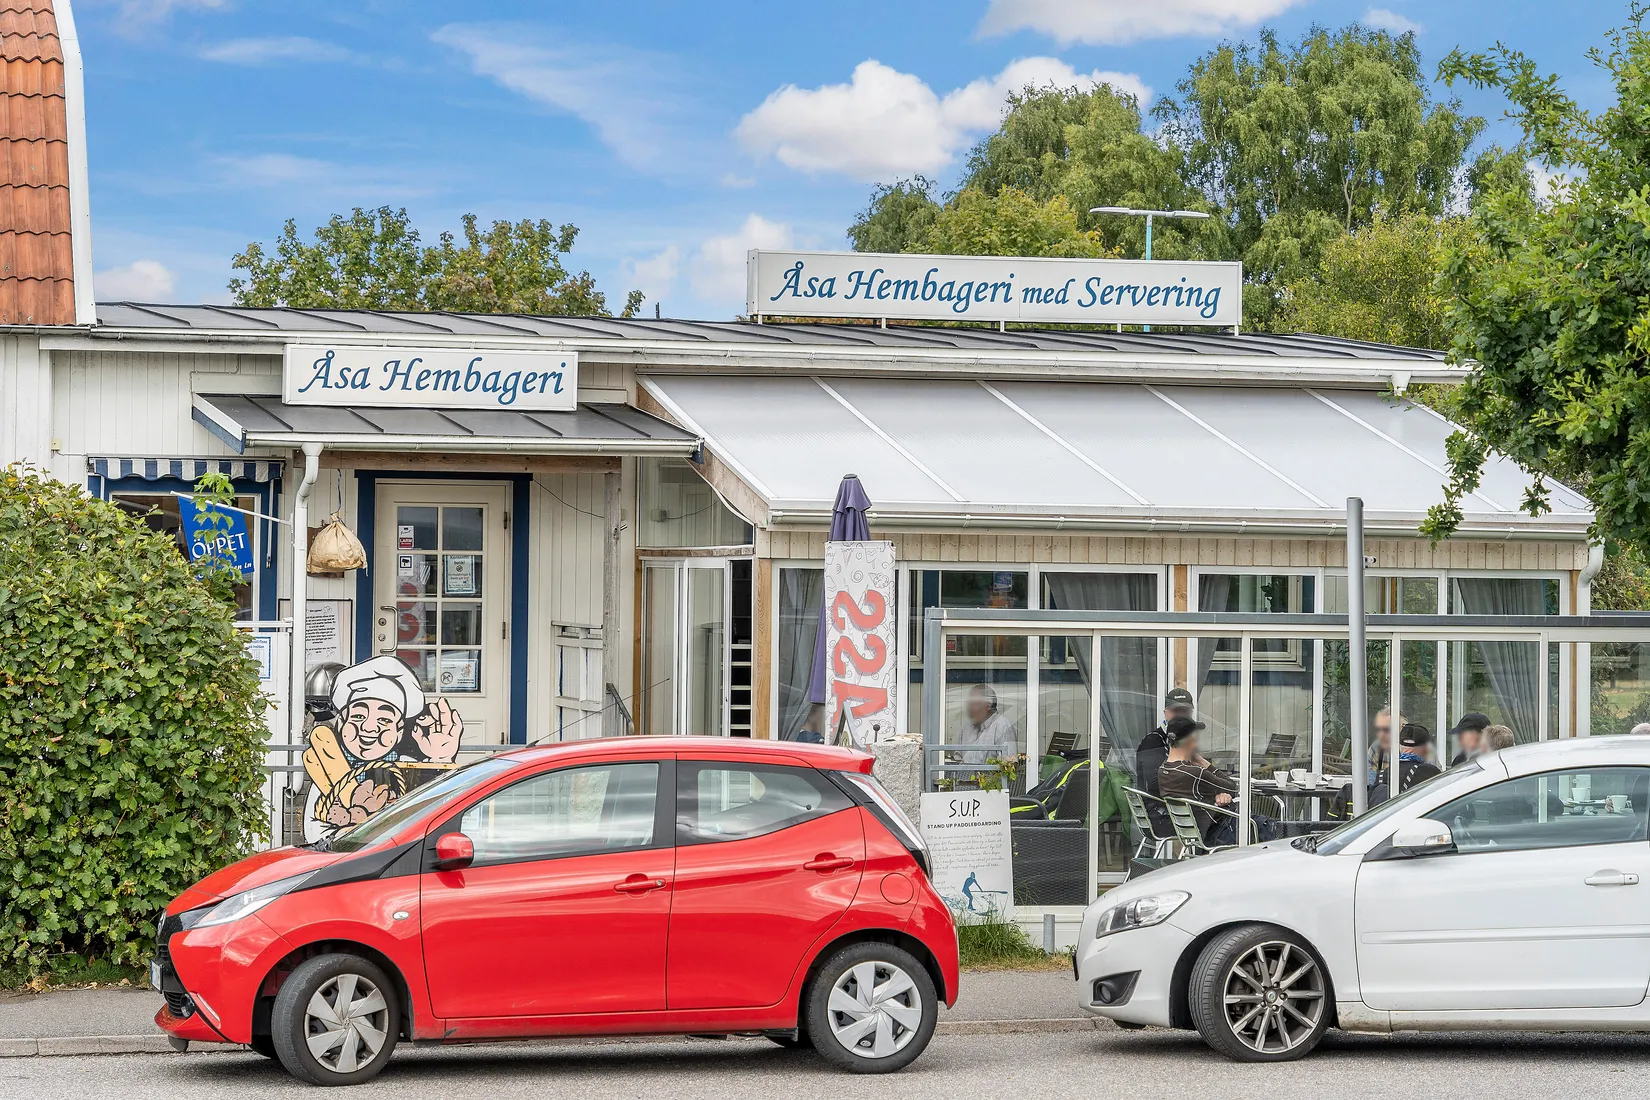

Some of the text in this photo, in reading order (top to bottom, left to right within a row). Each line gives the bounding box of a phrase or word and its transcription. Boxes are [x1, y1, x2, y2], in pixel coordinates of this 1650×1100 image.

[770, 260, 1222, 319] Åsa Hembageri med Servering
[298, 350, 567, 405] Åsa Hembageri
[192, 532, 245, 559] ÖPPET
[949, 798, 981, 818] S.U.P.
[954, 820, 1002, 828] PADDLEBOARDING
